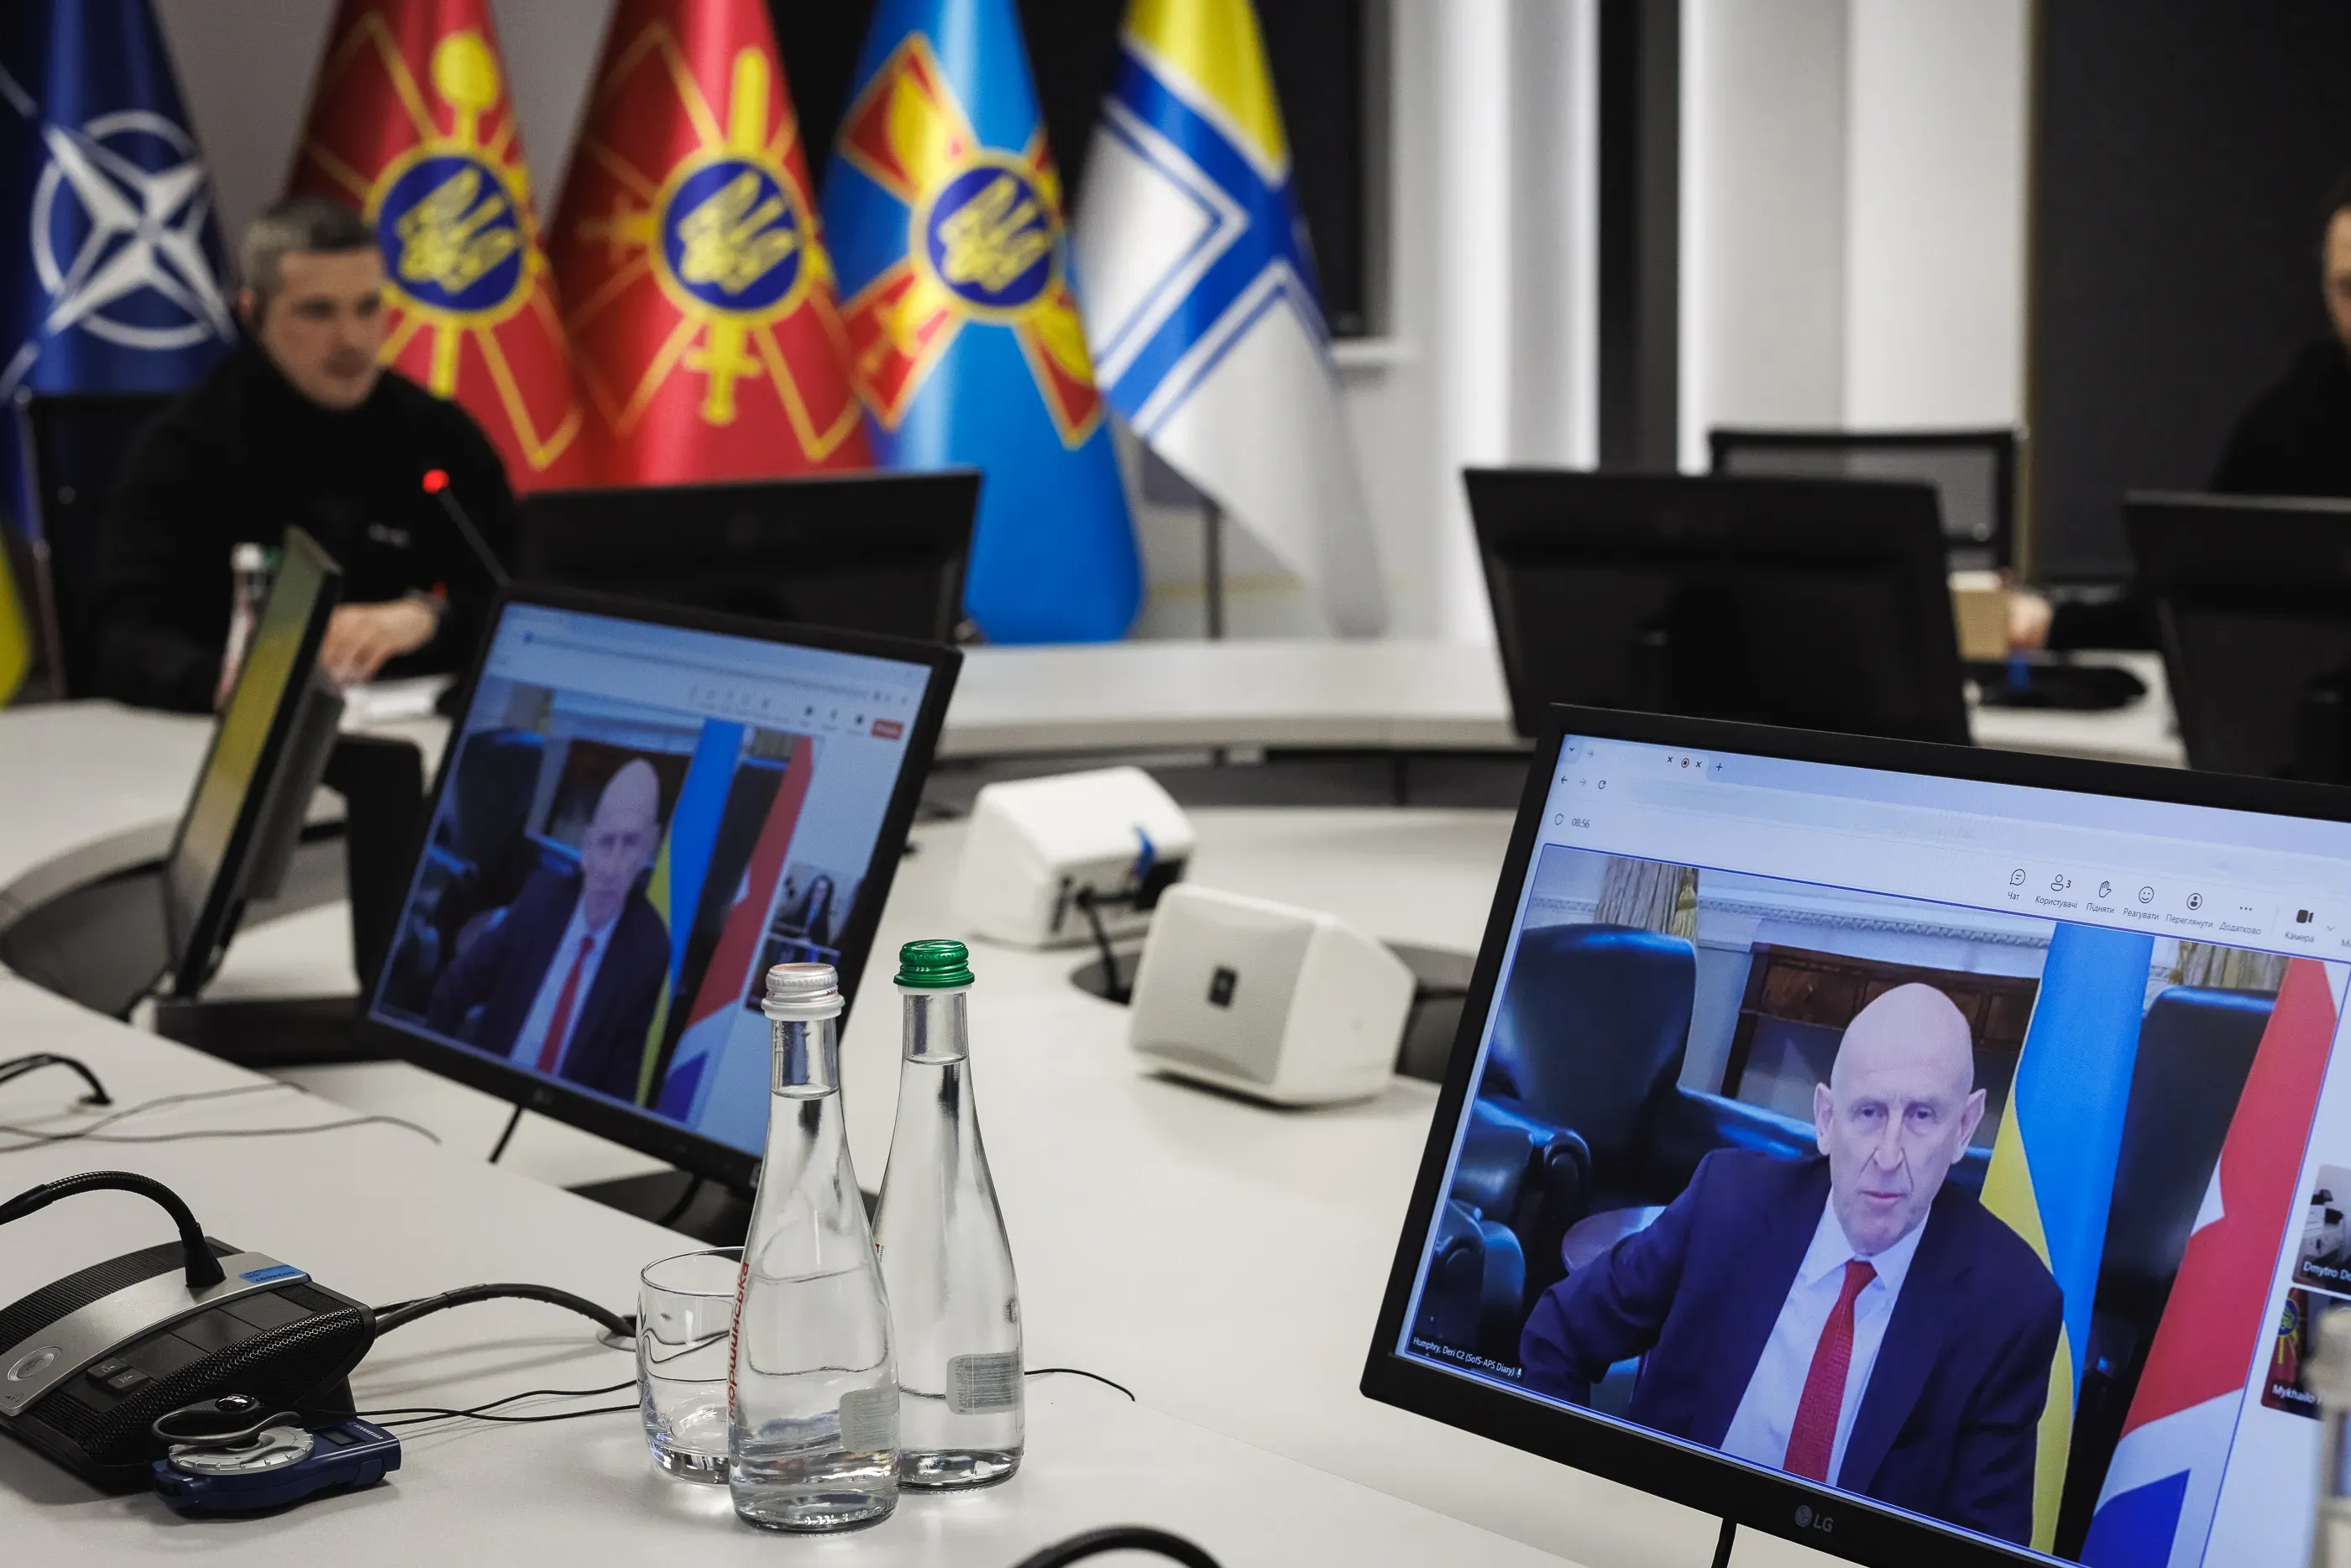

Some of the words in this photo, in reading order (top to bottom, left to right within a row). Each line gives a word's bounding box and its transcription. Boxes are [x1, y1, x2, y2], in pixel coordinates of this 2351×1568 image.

[2066, 880, 2071, 889] 3
[2008, 891, 2020, 901] Чат
[2034, 895, 2078, 909] Користувачі
[2086, 902, 2115, 914] Підняти
[2123, 907, 2160, 921] Реагувати
[2165, 913, 2214, 929] Переглянути
[2218, 922, 2262, 935] Додатково
[2285, 931, 2315, 943] Камера
[1456, 1350, 1465, 1361] C2
[1496, 1362, 1516, 1377] Diary)
[1813, 1513, 1834, 1534] LG
